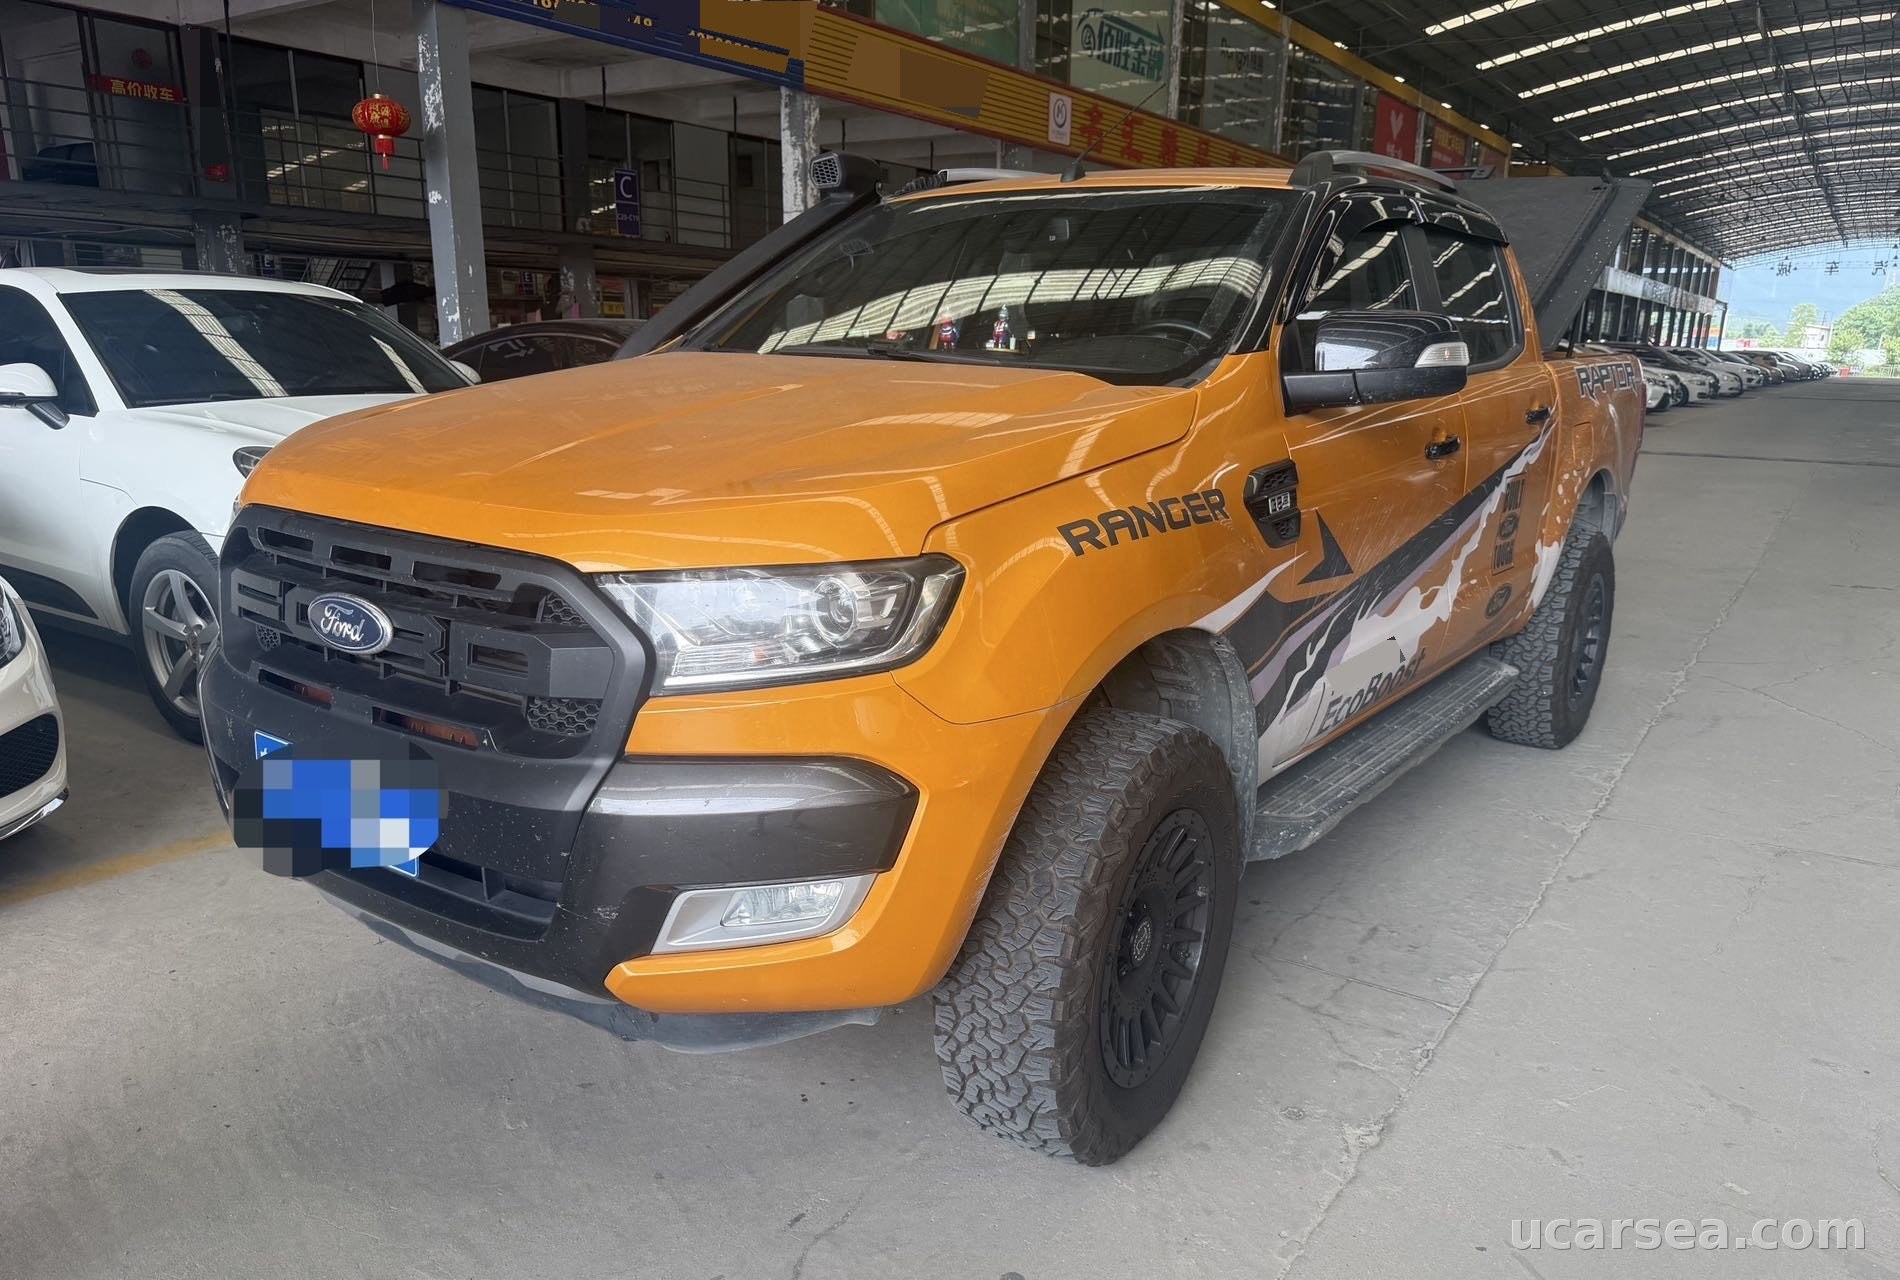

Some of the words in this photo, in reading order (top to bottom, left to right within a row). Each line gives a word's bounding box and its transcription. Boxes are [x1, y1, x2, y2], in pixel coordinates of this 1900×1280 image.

[110, 79, 175, 101] 高价收车
[620, 176, 633, 198] C
[1574, 361, 1638, 406] RAPTOR
[1056, 488, 1229, 557] RANGER
[320, 604, 365, 644] Ford
[1317, 647, 1428, 733] EcoBoost
